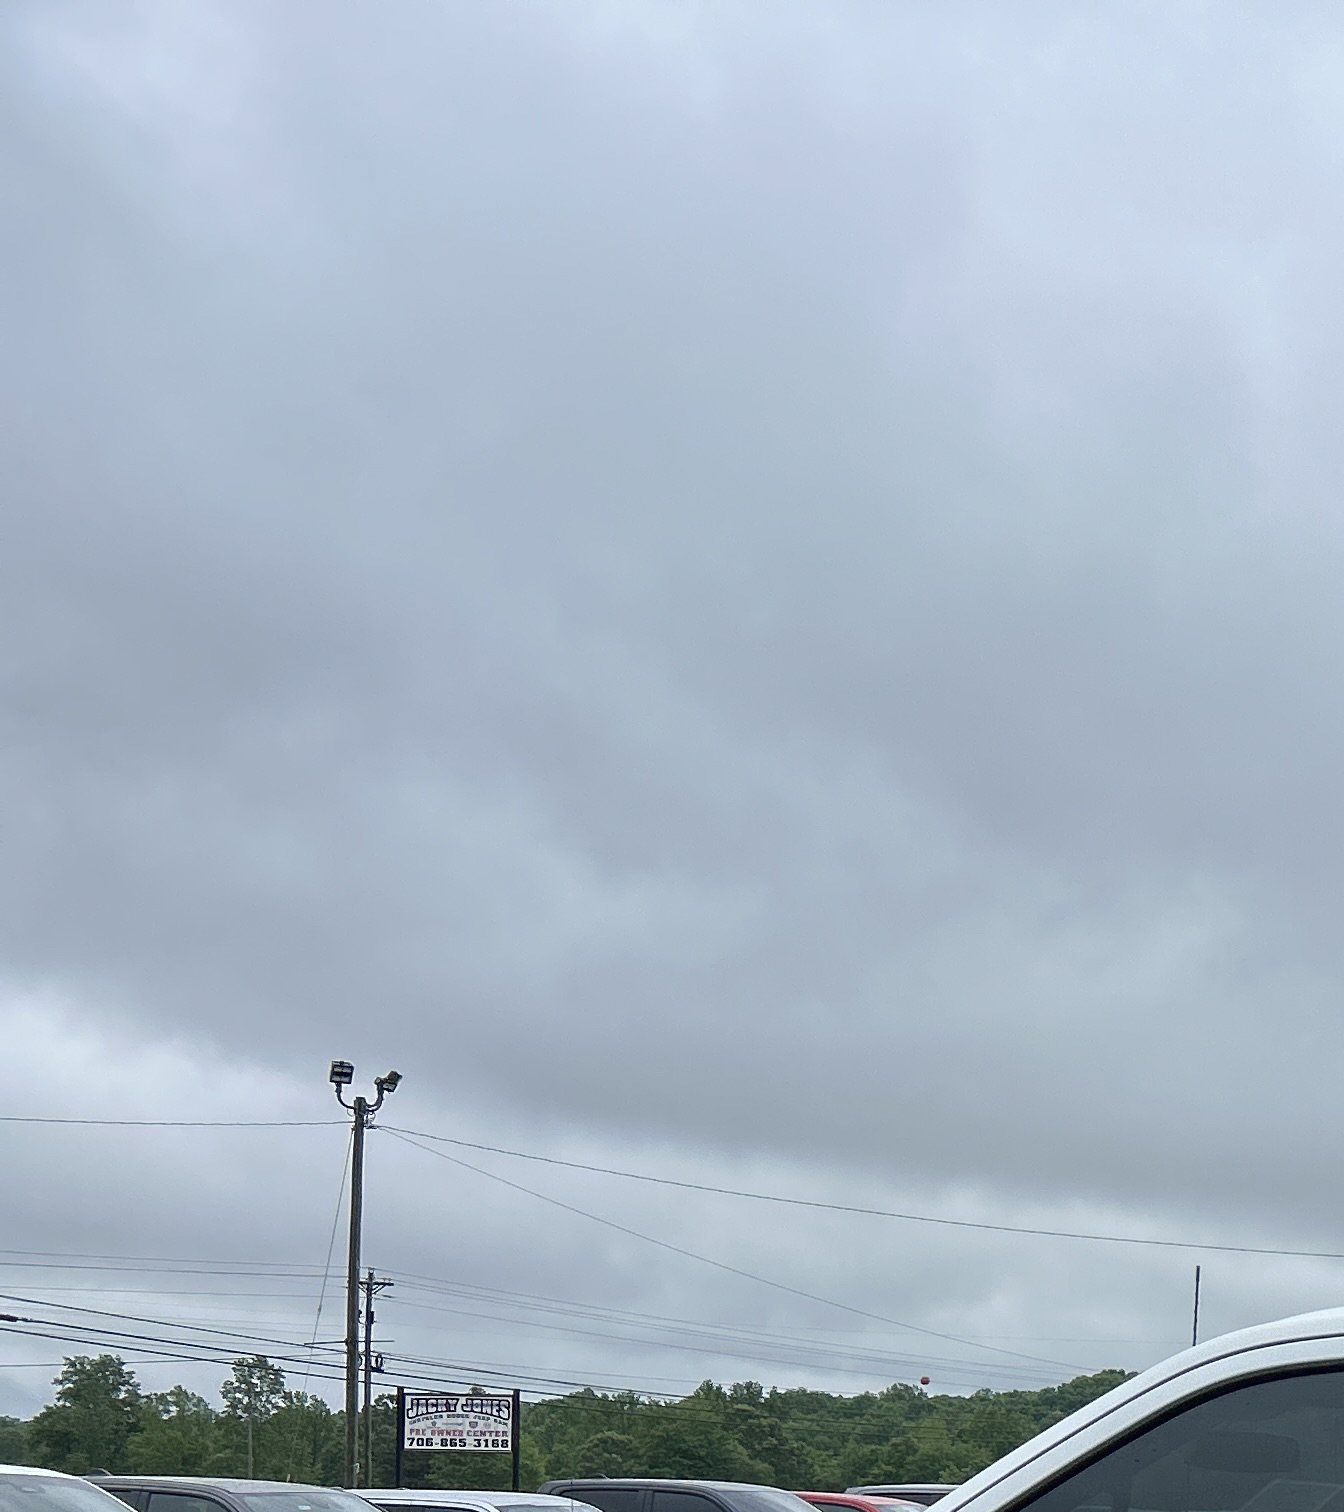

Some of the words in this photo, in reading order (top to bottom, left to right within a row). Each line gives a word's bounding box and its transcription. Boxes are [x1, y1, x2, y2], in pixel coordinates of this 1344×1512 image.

[407, 1398, 460, 1419] JACKY
[461, 1398, 510, 1420] JONES
[466, 1430, 508, 1438] CENTER
